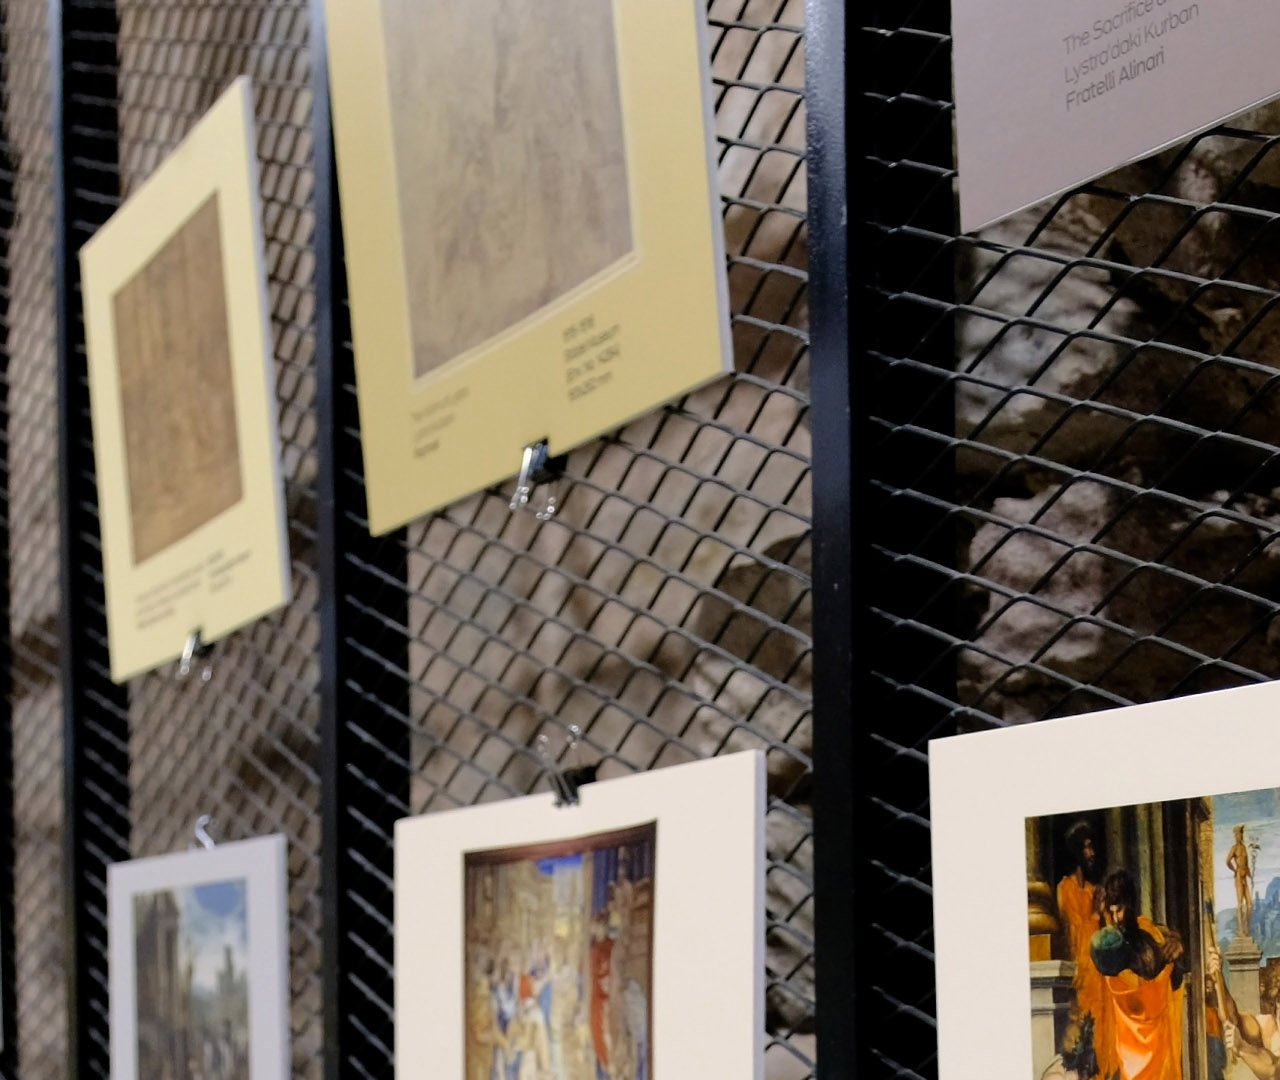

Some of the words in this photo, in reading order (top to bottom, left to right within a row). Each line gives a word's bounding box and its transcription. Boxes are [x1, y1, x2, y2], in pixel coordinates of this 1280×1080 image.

[1062, 30, 1089, 54] The
[1093, 0, 1153, 40] Sacrifice
[1065, 28, 1142, 84] Lystra'daki
[1144, 4, 1199, 43] Kurban
[1066, 70, 1115, 111] Fratelli
[1118, 46, 1165, 86] Alinari
